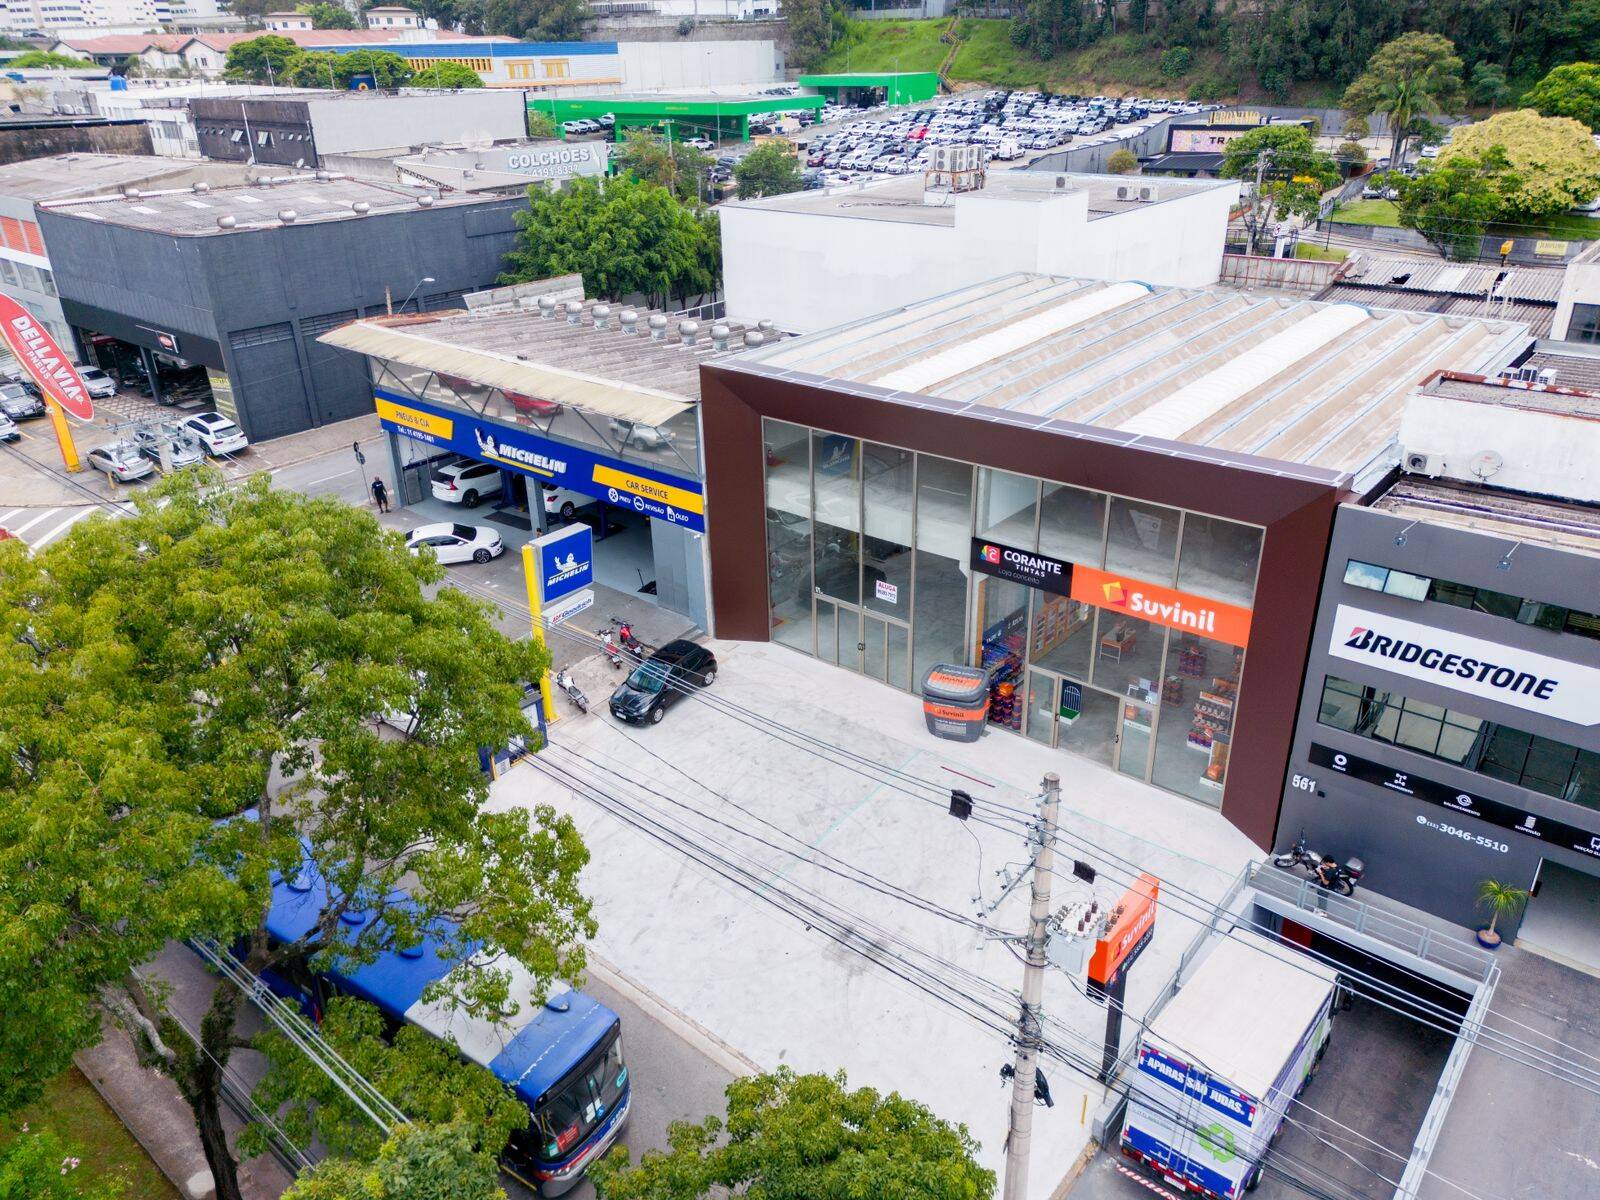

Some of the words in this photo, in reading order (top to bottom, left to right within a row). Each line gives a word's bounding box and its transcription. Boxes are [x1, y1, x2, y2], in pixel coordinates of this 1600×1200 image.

[509, 147, 589, 168] COLCHÕES
[27, 351, 51, 380] PNEUS
[499, 443, 567, 474] MICHELIN
[626, 480, 640, 491] CAR
[641, 484, 668, 500] SERVICE
[547, 564, 589, 587] MICHELIN
[1004, 550, 1062, 575] CORANTE
[1016, 564, 1046, 578] TINTAS
[1130, 592, 1215, 633] Suvinil
[1344, 627, 1558, 700] BRIDGESTONE
[942, 709, 964, 718] Suvinil
[1292, 774, 1316, 792] 561
[1439, 824, 1508, 853] 3046-5510
[1121, 900, 1156, 951] Suvinil
[1147, 1057, 1186, 1084] APARAS
